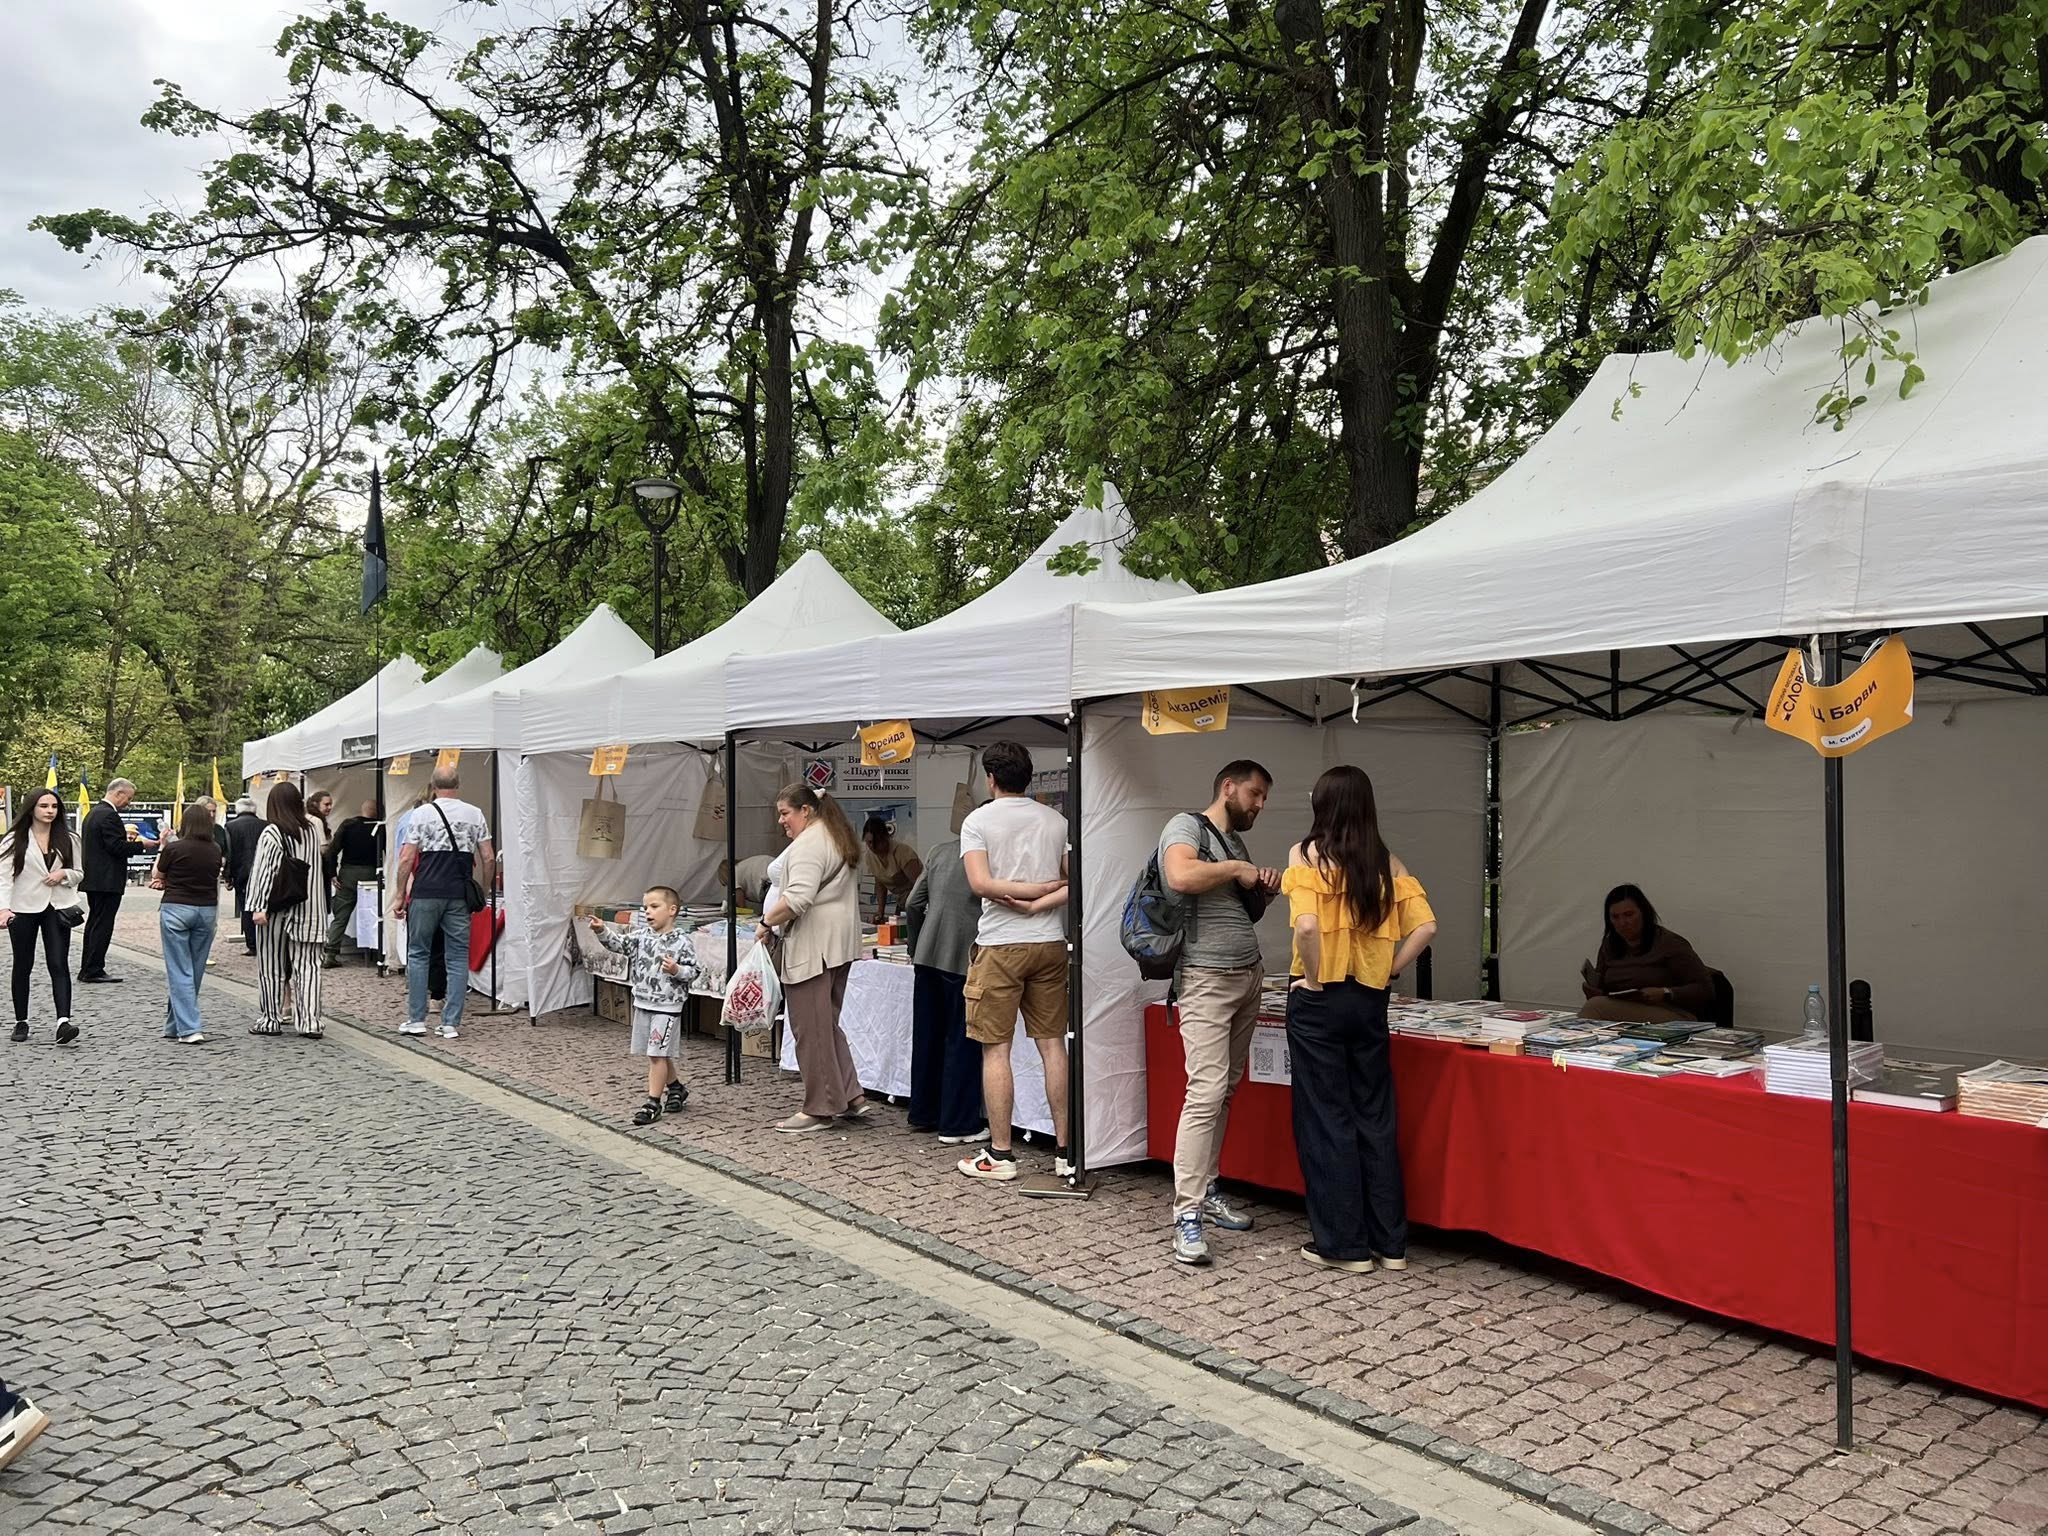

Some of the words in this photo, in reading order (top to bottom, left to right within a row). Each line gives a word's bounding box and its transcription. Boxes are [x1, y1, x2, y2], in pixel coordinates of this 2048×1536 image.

[1830, 680, 1877, 720] Барви
[868, 731, 905, 750] Фрейда
[843, 767, 909, 777] «Підруники
